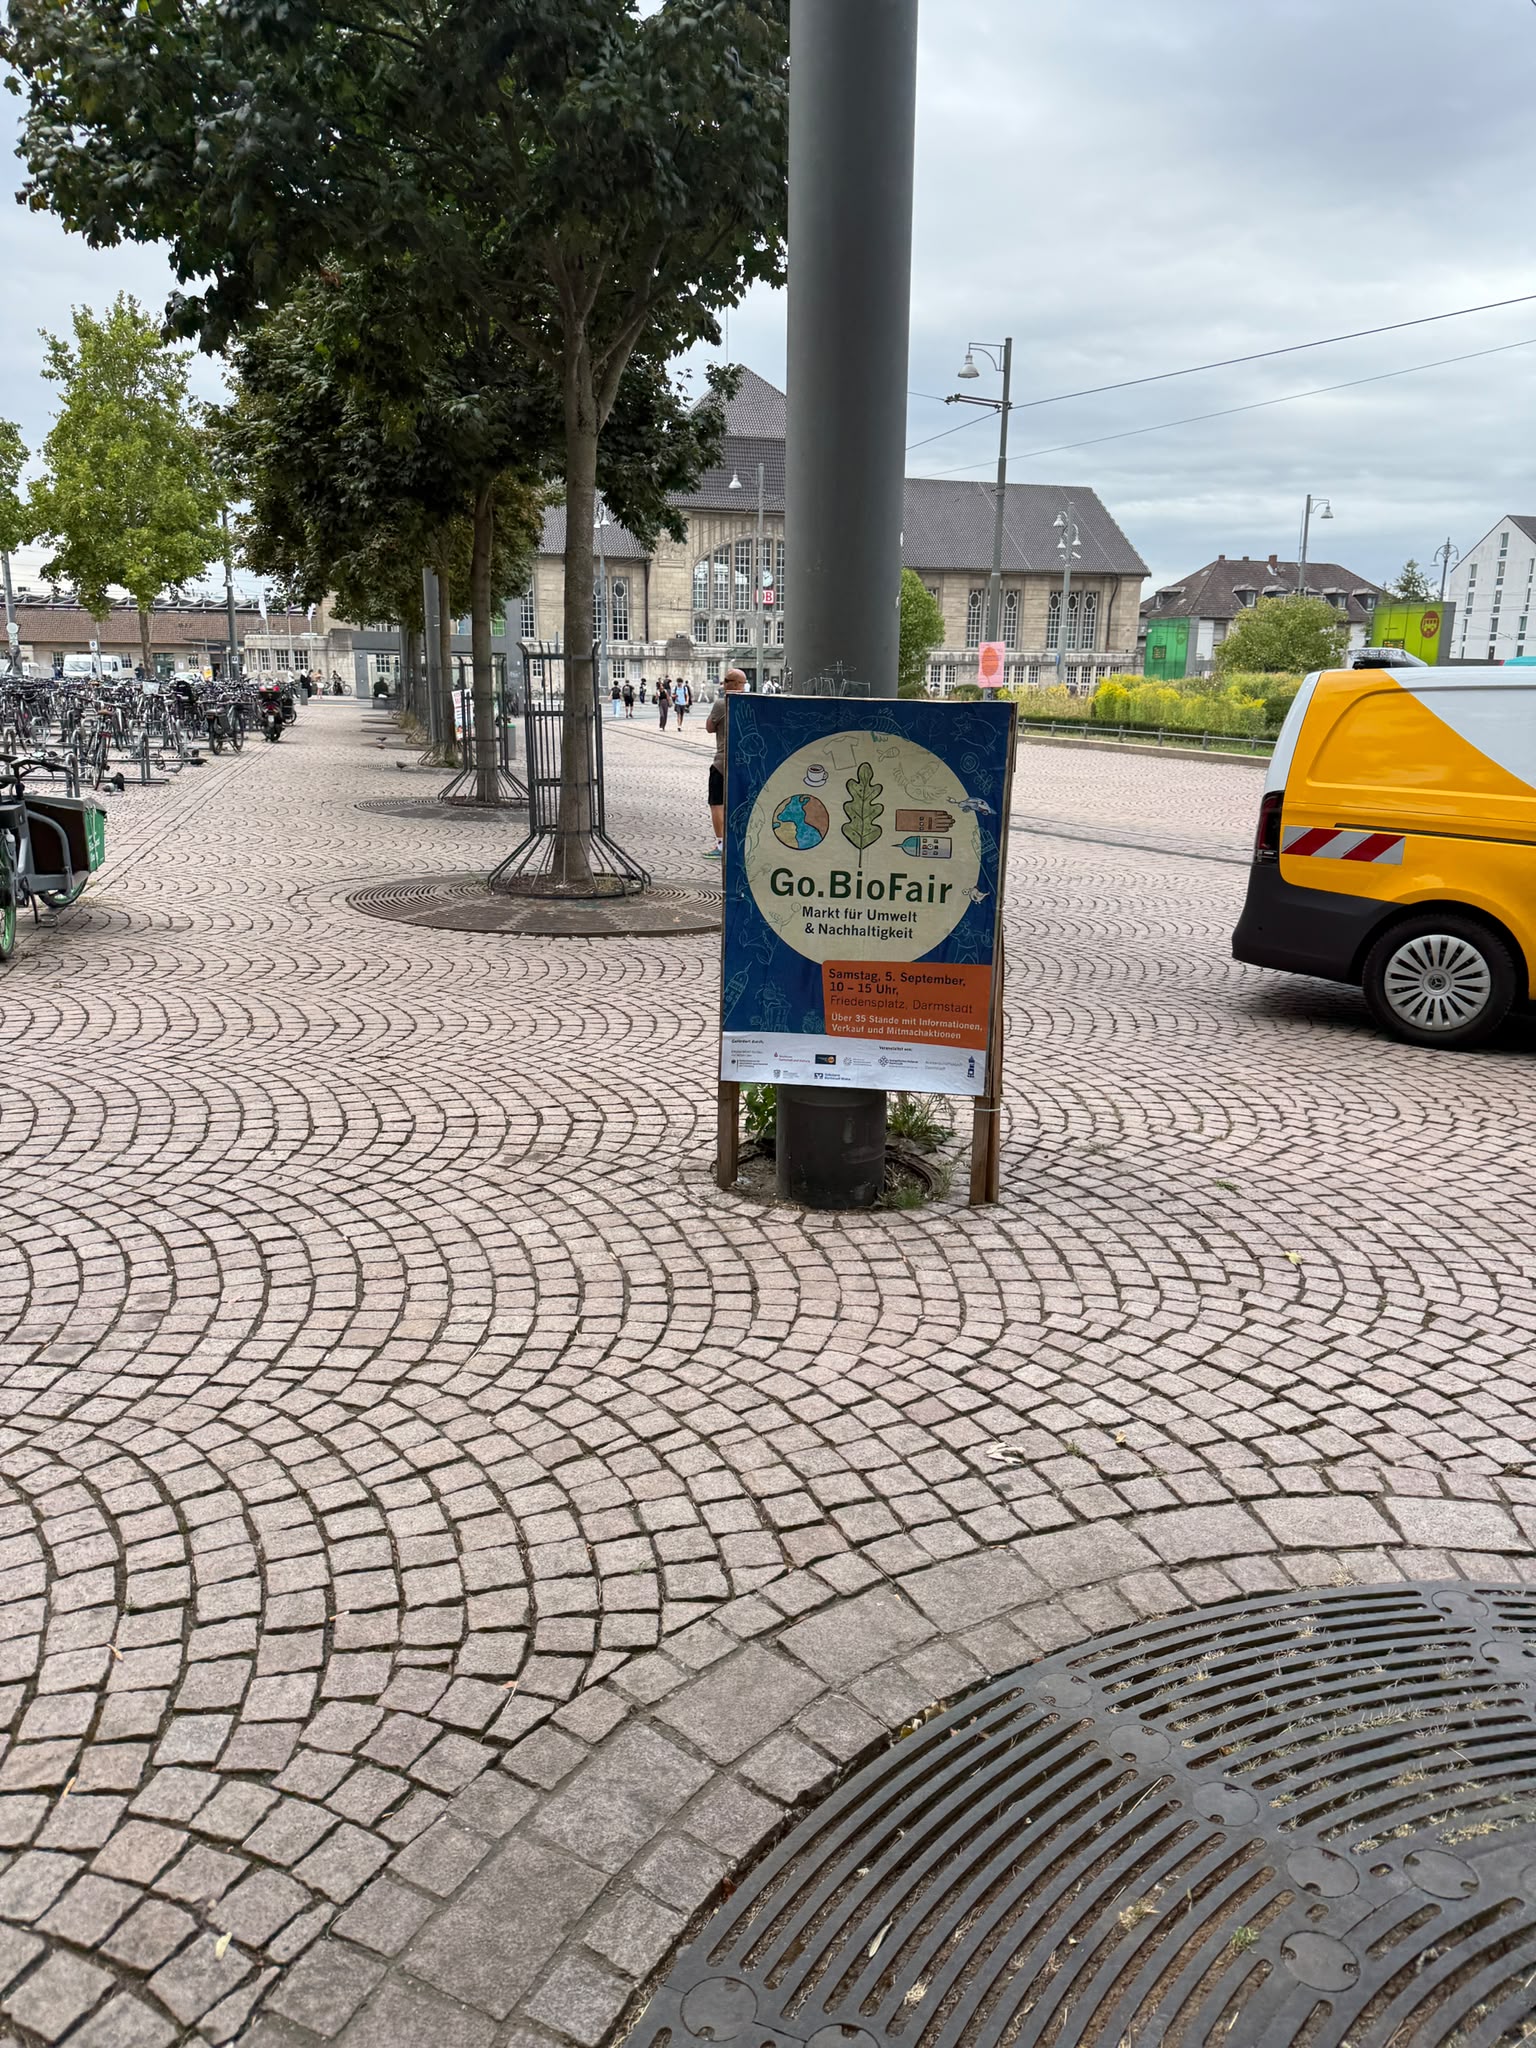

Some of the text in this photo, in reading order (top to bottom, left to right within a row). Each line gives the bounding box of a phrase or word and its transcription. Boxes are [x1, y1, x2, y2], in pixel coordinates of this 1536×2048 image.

[770, 867, 953, 904] Go.BioFair
[802, 906, 918, 923] Markt für Umwelt
[804, 922, 914, 941] & Nachhaltigkeit
[828, 968, 966, 987] Samstag, 5. September,
[829, 981, 844, 992] 10
[858, 983, 872, 994] 15
[876, 983, 899, 996] Uhr,
[830, 995, 973, 1014] Friedensplatz, Darmstadt
[831, 1011, 853, 1022] Über
[855, 1014, 866, 1023] 35
[869, 1015, 899, 1025] Stände
[901, 1017, 917, 1025] mit
[831, 1024, 962, 1040] Verkauf und Mitmachaktionen
